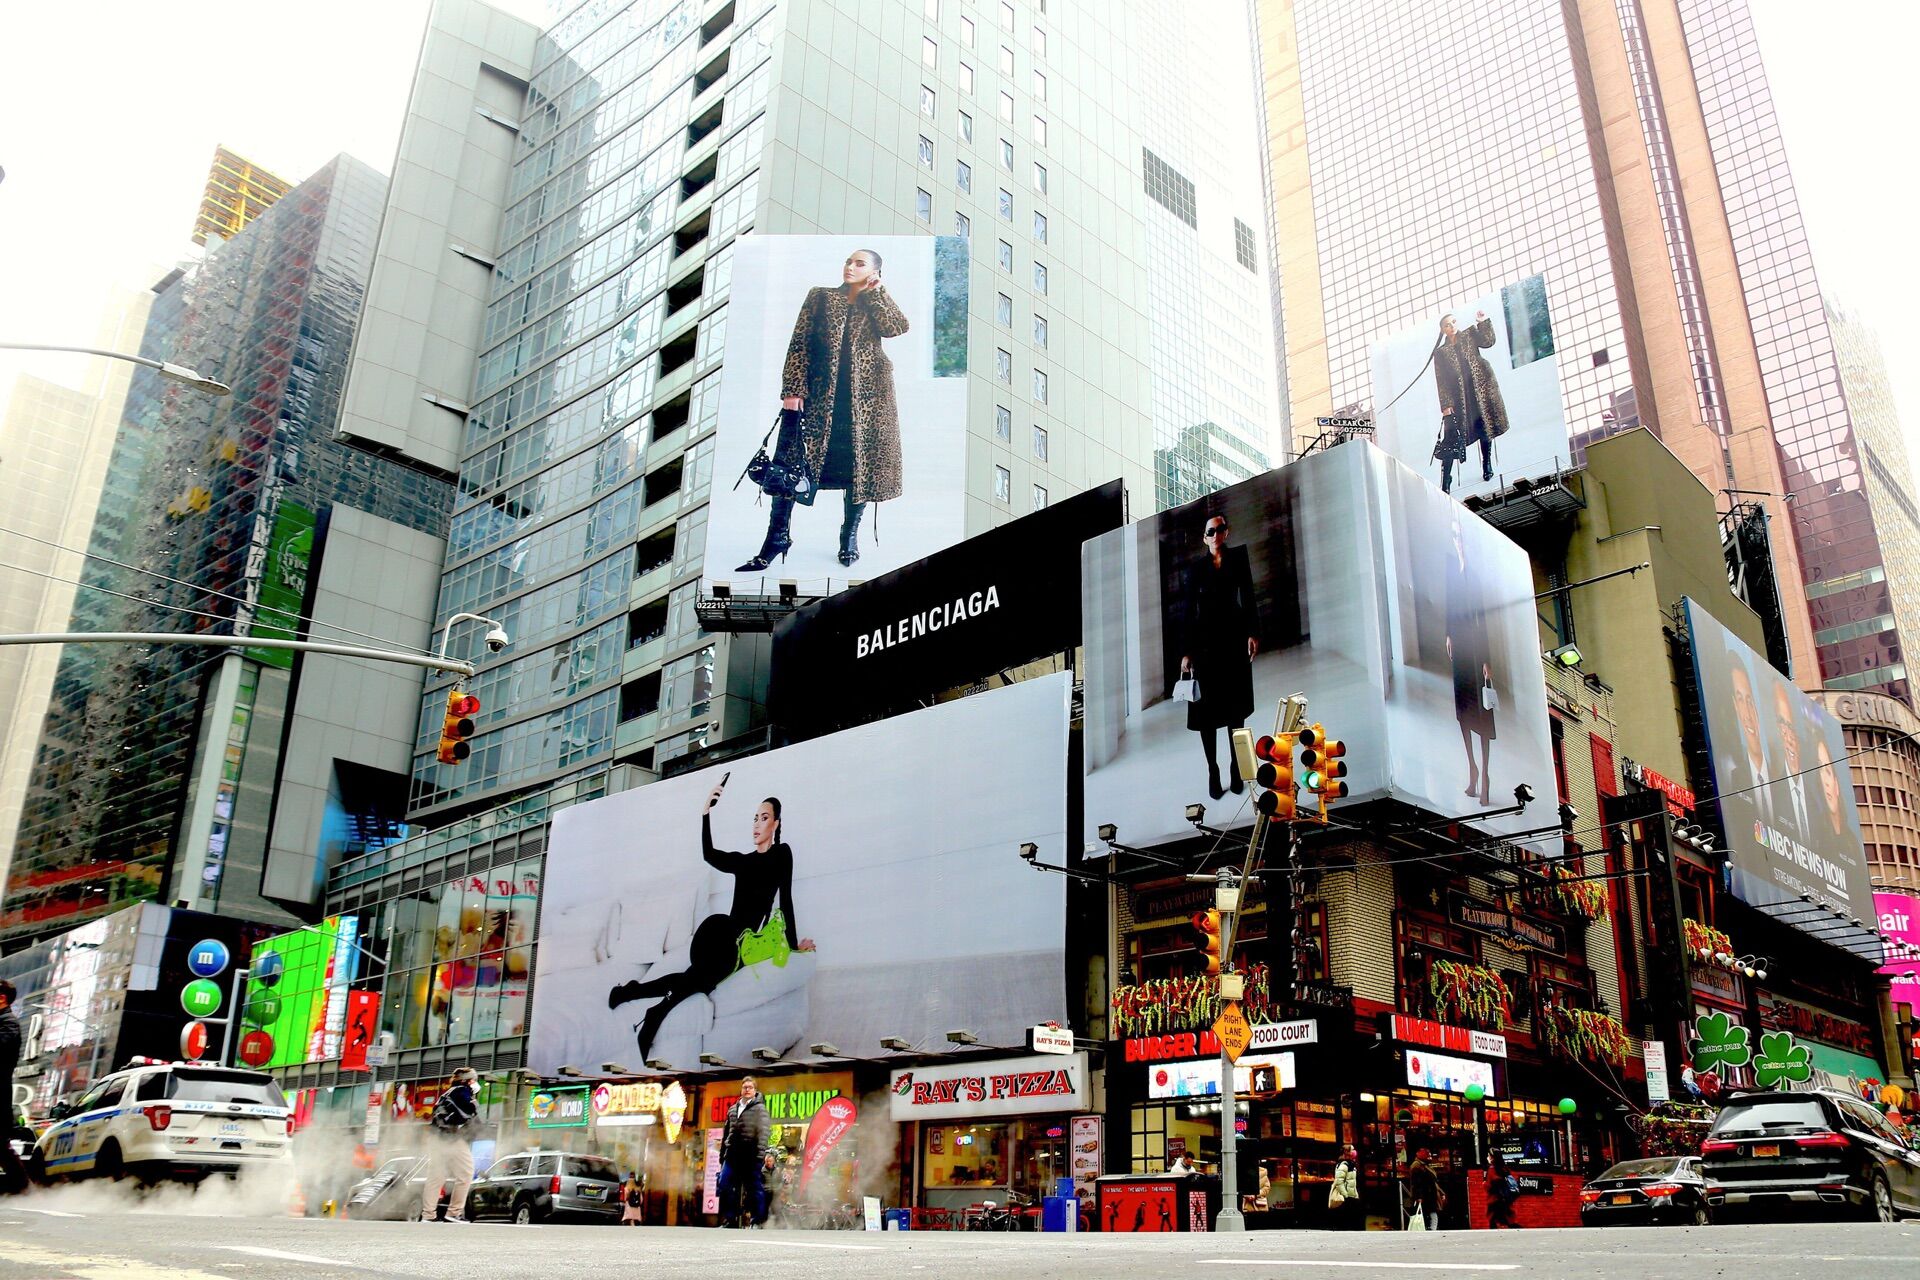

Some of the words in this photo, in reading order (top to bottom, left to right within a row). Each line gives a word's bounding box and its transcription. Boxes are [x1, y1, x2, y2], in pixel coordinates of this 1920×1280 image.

[857, 585, 1000, 659] BALENCIAGA
[1836, 695, 1900, 727] GRILL
[1767, 826, 1793, 861] NBC
[1792, 841, 1824, 879] NEWS
[1823, 859, 1848, 891] NOW
[1877, 908, 1910, 931] air
[197, 952, 214, 964] m
[194, 991, 211, 1005] m
[1223, 1014, 1242, 1025] RIGHT
[1036, 1037, 1053, 1045] RAY'S
[1054, 1039, 1071, 1047] PIZZA
[1125, 1032, 1197, 1062] BURGER
[1254, 1028, 1278, 1043] FOOD
[1281, 1024, 1310, 1041] COURT
[1224, 1026, 1242, 1037] LANE
[1225, 1037, 1242, 1048] ENDS
[1395, 1013, 1443, 1047] BURGER
[1474, 1035, 1488, 1050] FOOD
[1489, 1038, 1504, 1053] COURT
[912, 1076, 985, 1105] RAY'S
[990, 1069, 1075, 1100] PIZZA
[561, 1100, 583, 1117] WORLD
[764, 1092, 787, 1119] THE
[789, 1089, 840, 1120] SQUA
[826, 1121, 847, 1146] PIZZA
[1519, 1177, 1538, 1189] Subway
